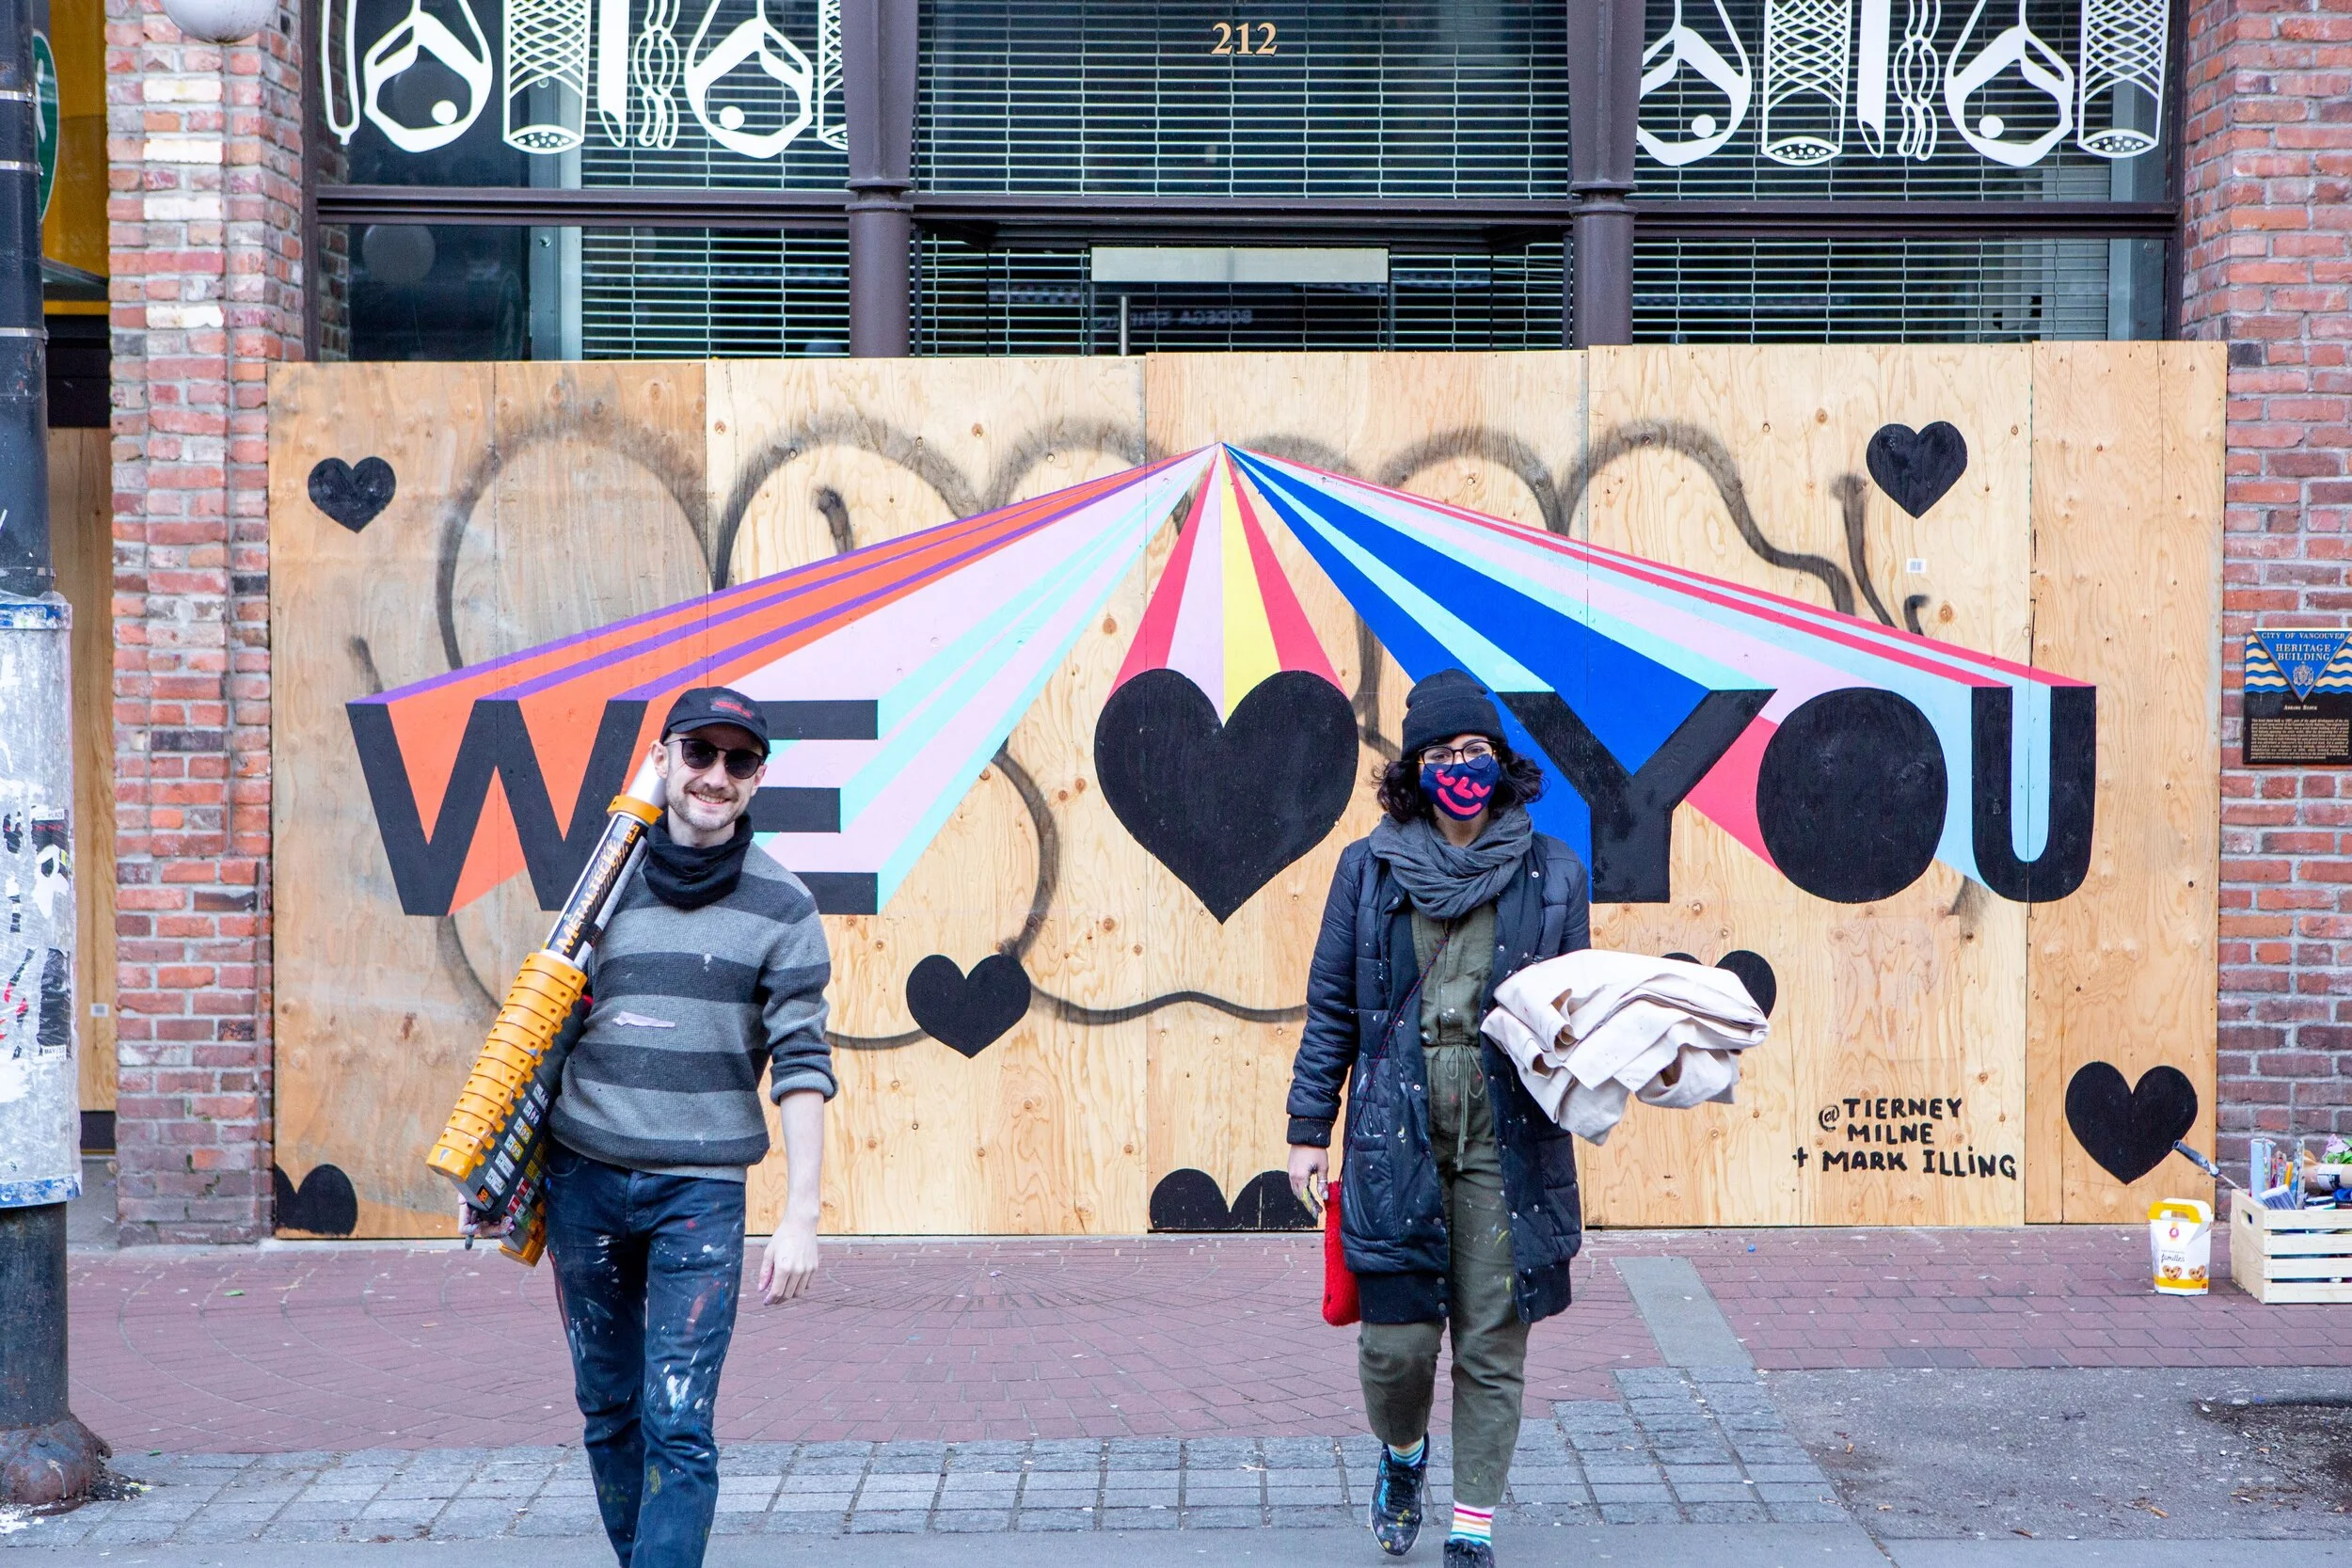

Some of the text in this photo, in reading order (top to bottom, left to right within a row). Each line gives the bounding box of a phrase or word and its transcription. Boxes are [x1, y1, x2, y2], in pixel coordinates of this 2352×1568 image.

[1210, 22, 1279, 56] 212
[2275, 643, 2331, 652] HERITAGE
[2278, 652, 2330, 661] BUILDING
[1497, 686, 2097, 904] YOU
[1847, 1123, 1934, 1145] MILNE
[1822, 1150, 1908, 1172] MARK
